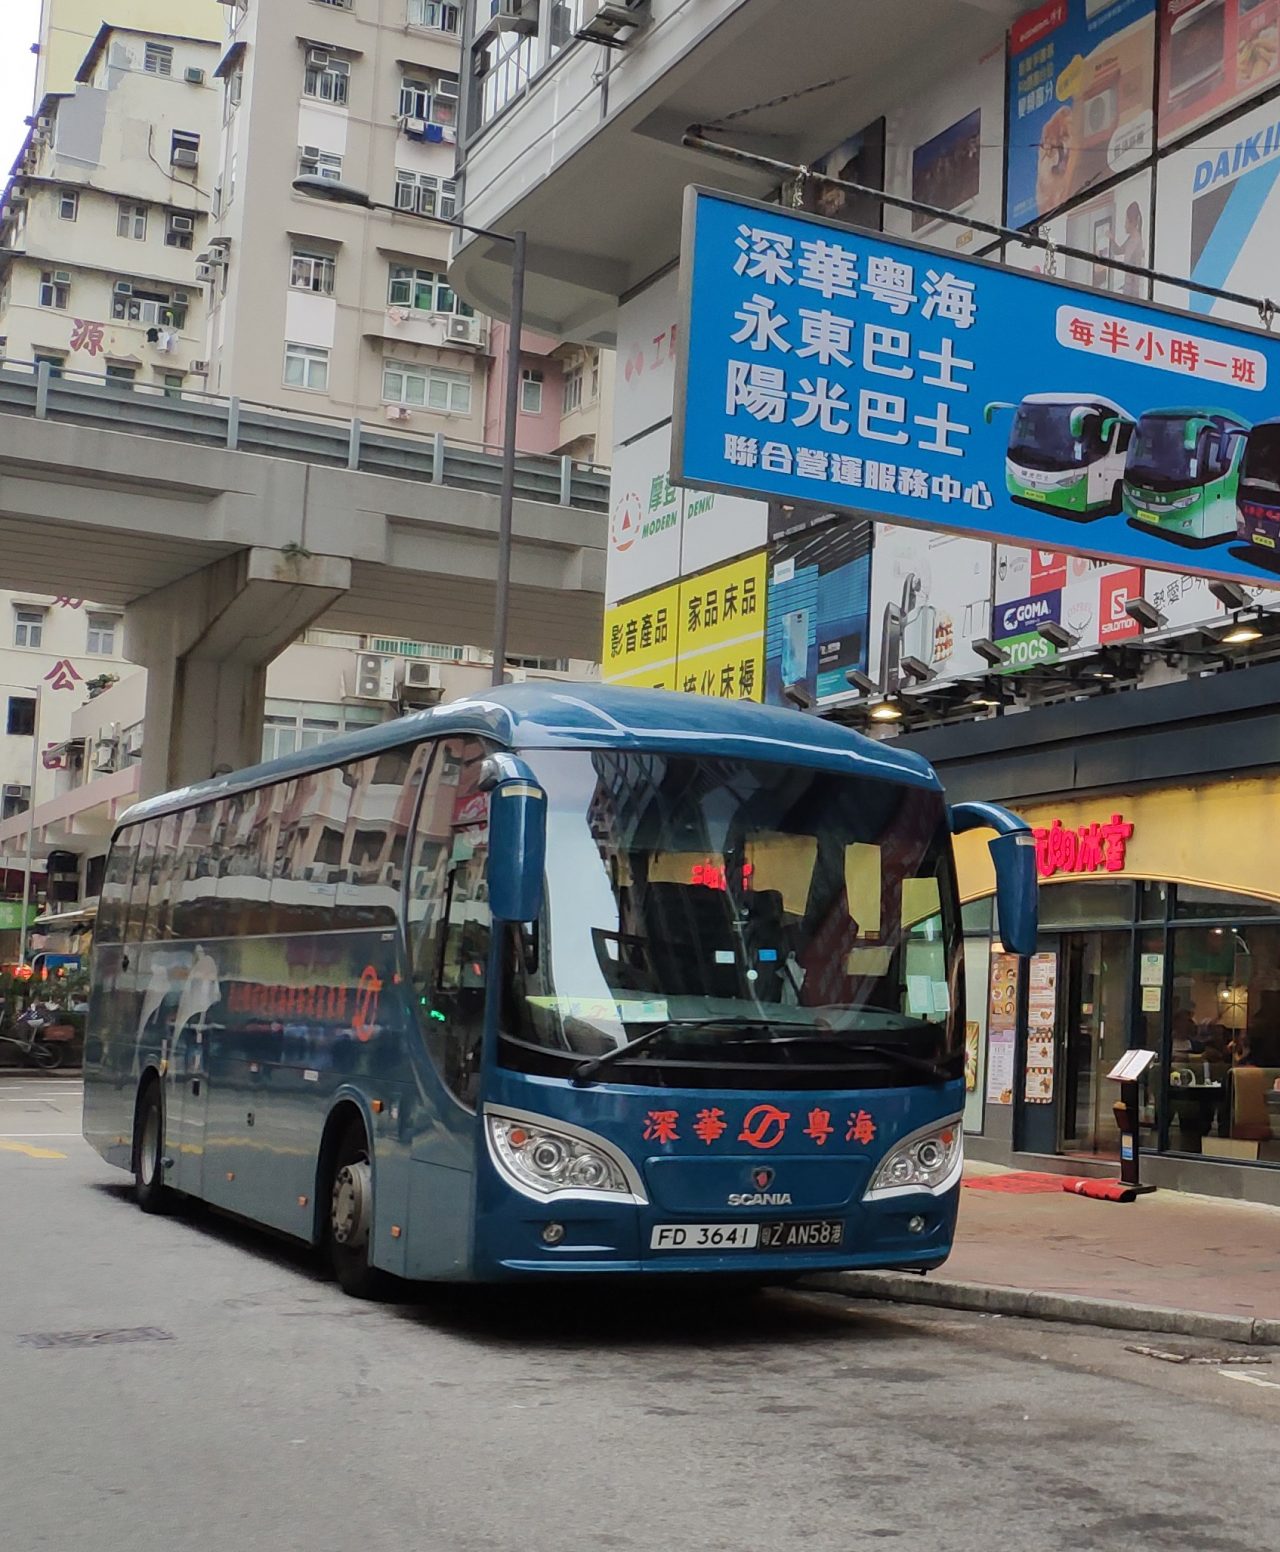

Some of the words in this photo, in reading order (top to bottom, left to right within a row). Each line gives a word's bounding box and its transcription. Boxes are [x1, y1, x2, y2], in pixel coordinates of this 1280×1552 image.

[70, 319, 105, 356] 源
[730, 293, 974, 393] 永東巴士
[1069, 318, 1255, 384] 每半小時一班
[725, 359, 970, 457] 陽光巴士
[724, 433, 993, 510] 聯合營運服務中心
[642, 511, 678, 540] MODERN
[687, 494, 715, 520] DENKI
[611, 607, 668, 659] 影音產品
[688, 577, 756, 632] 家品床品
[1017, 600, 1050, 621] GOMA
[642, 1107, 727, 1145] 深華
[728, 1193, 792, 1206] SCANIA
[658, 1228, 687, 1245] FD
[696, 1227, 748, 1245] 3641
